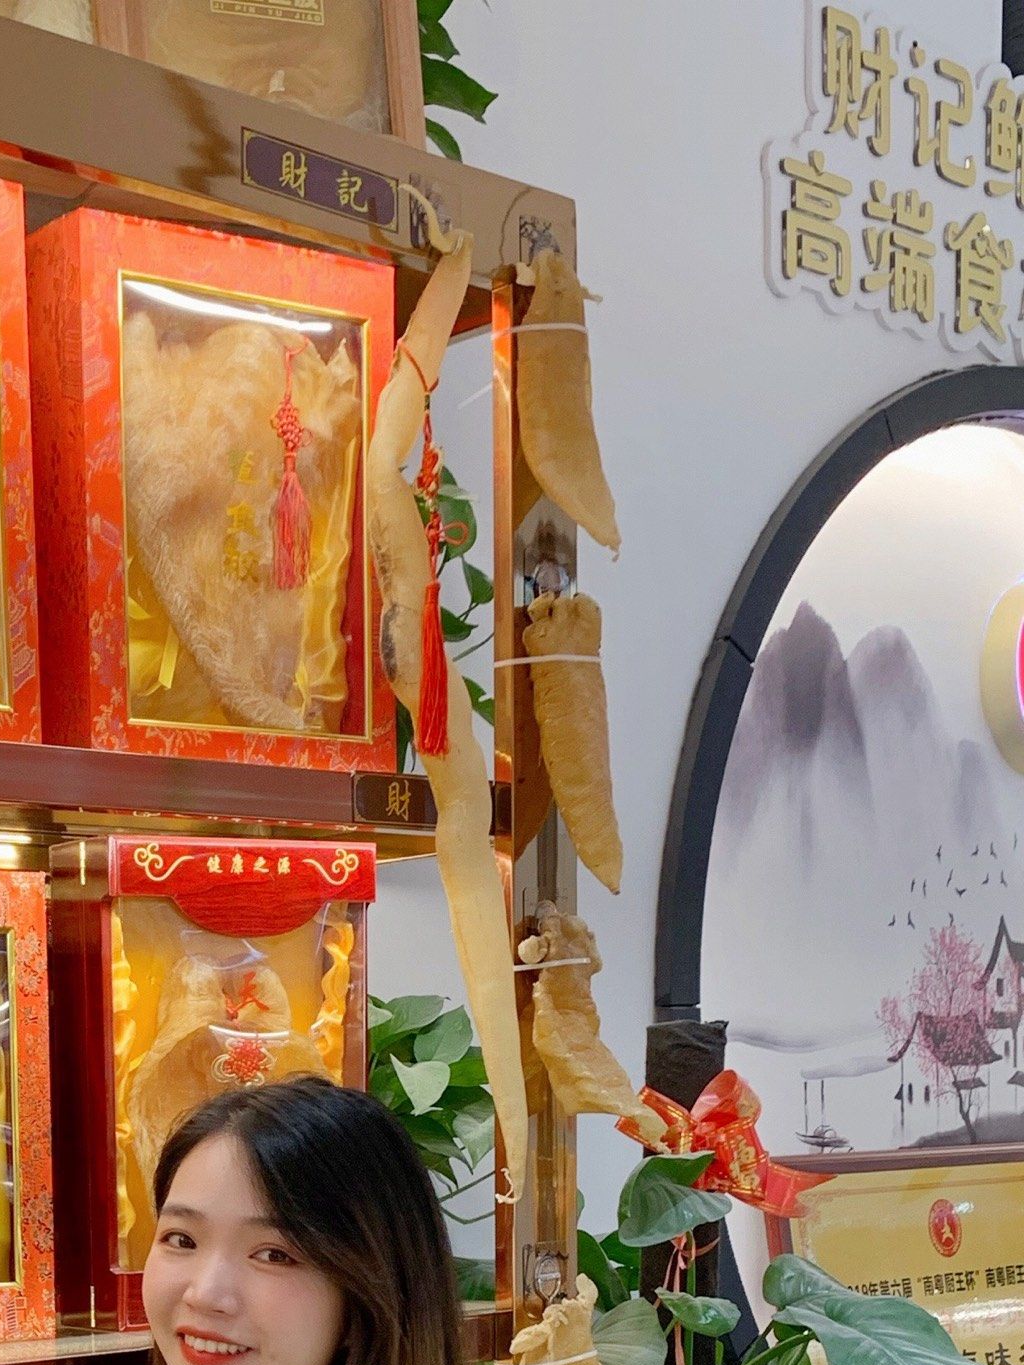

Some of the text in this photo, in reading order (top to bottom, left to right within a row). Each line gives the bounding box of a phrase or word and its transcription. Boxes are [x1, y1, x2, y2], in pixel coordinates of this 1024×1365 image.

[277, 150, 371, 214] 財記
[779, 150, 1024, 344] 高端食
